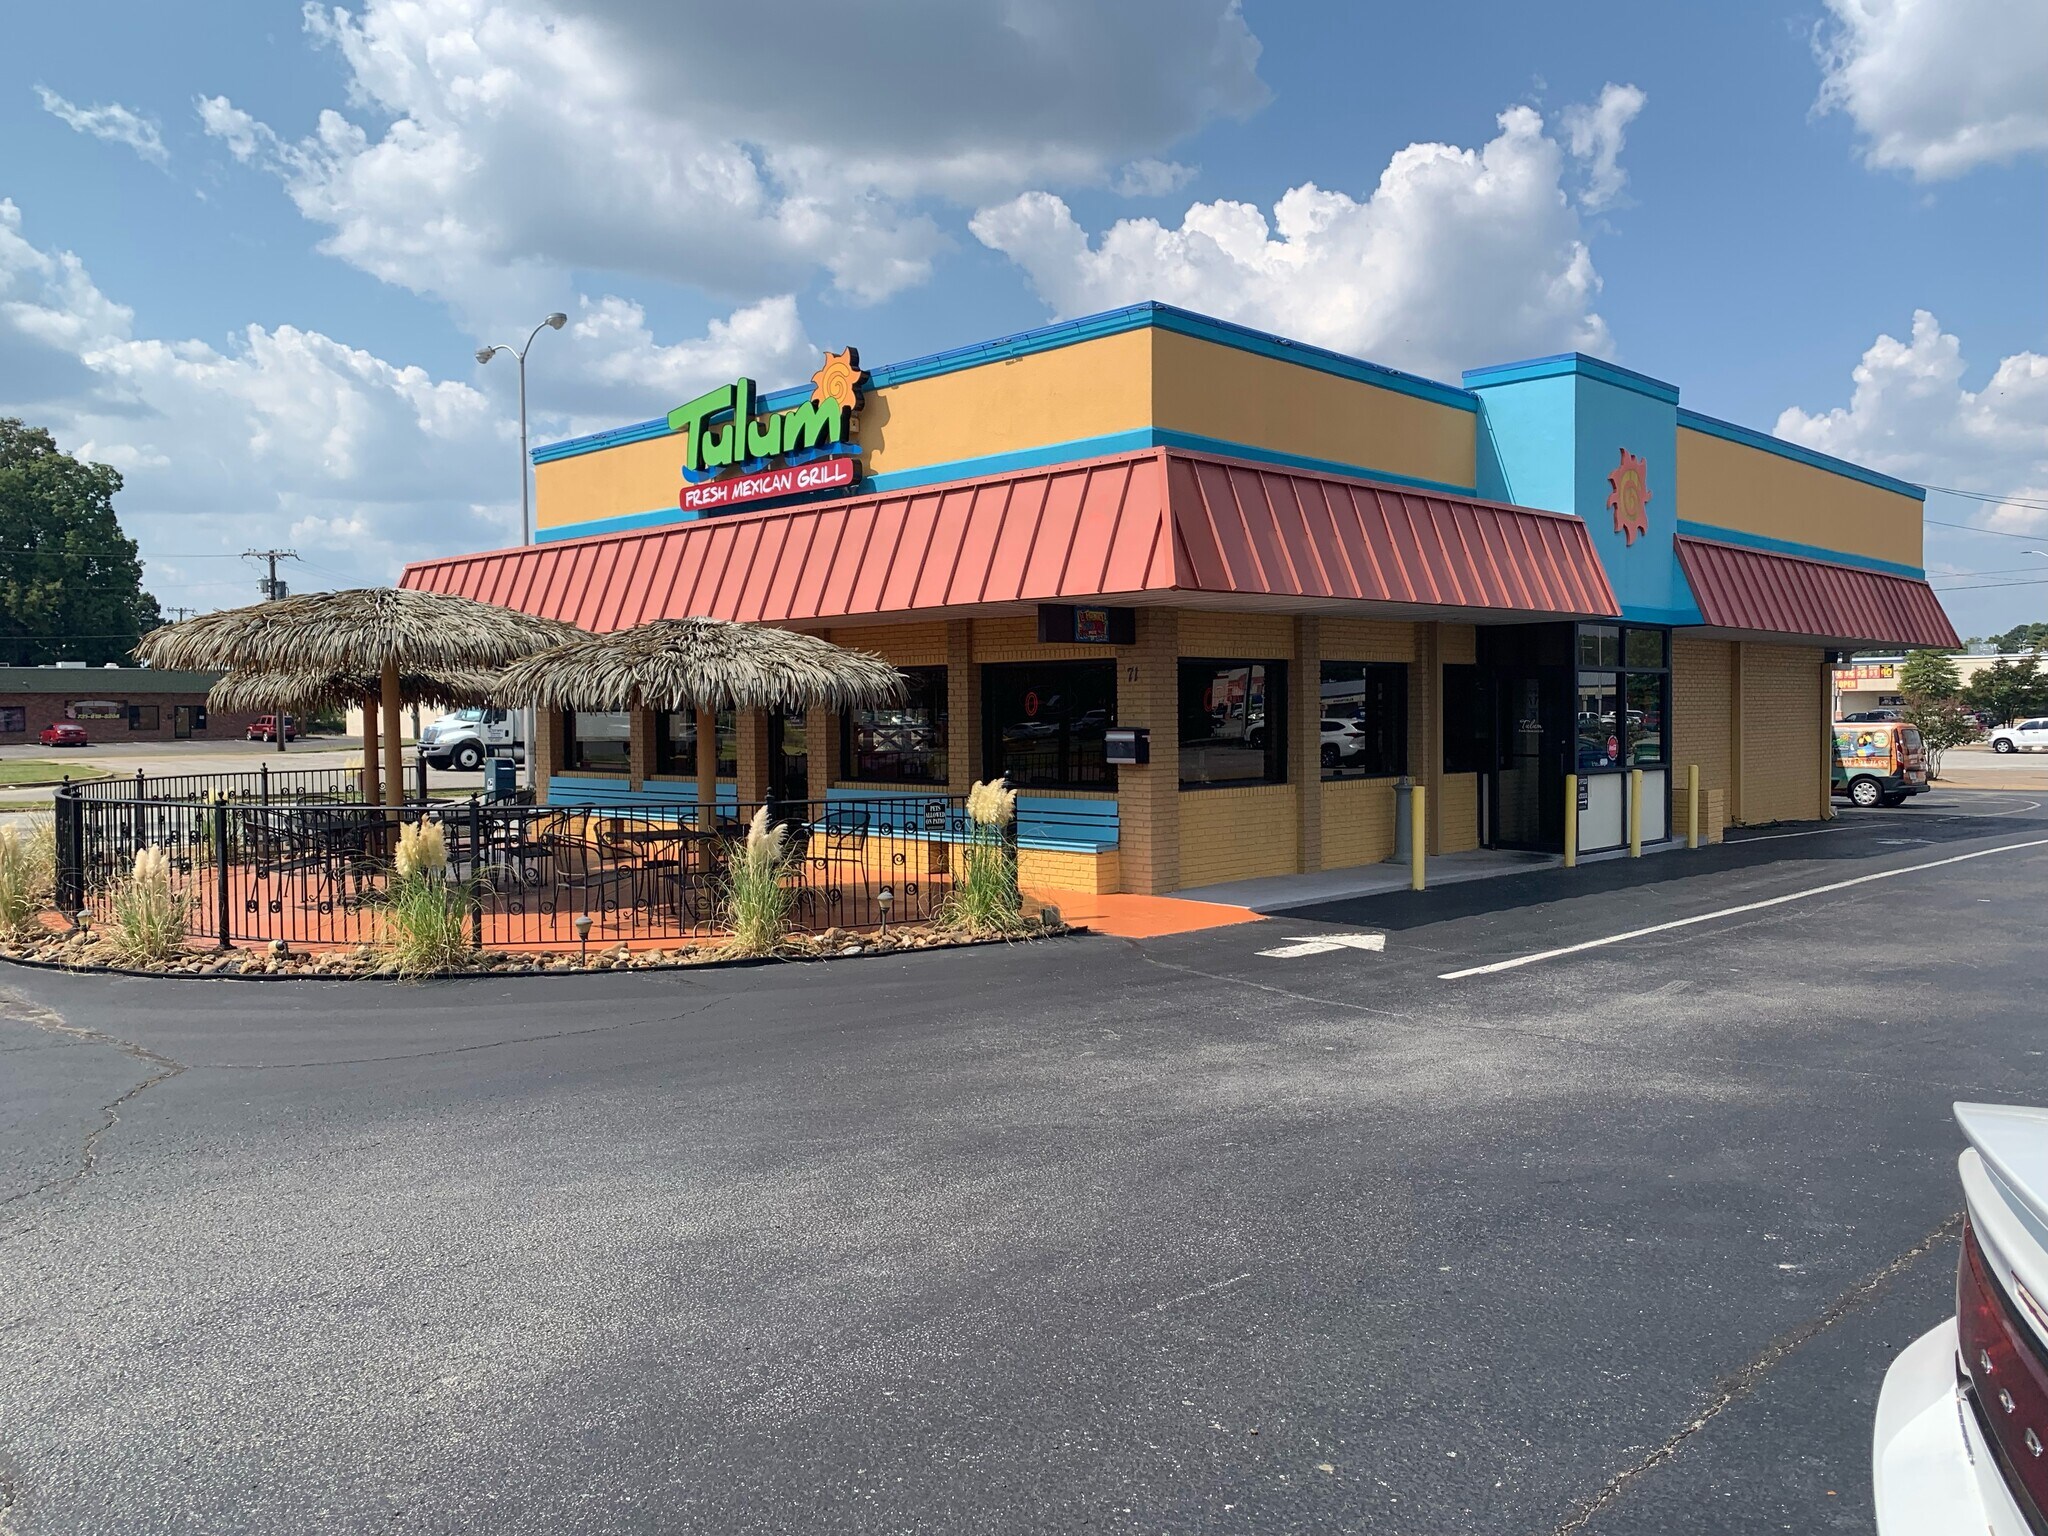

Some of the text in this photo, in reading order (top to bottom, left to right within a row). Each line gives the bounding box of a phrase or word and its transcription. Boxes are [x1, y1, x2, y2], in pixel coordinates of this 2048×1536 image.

[667, 377, 841, 471] Tulum
[685, 464, 848, 507] FRESH MEXICAN GRILL
[1127, 667, 1139, 682] 71
[1838, 680, 1856, 689] OPEN
